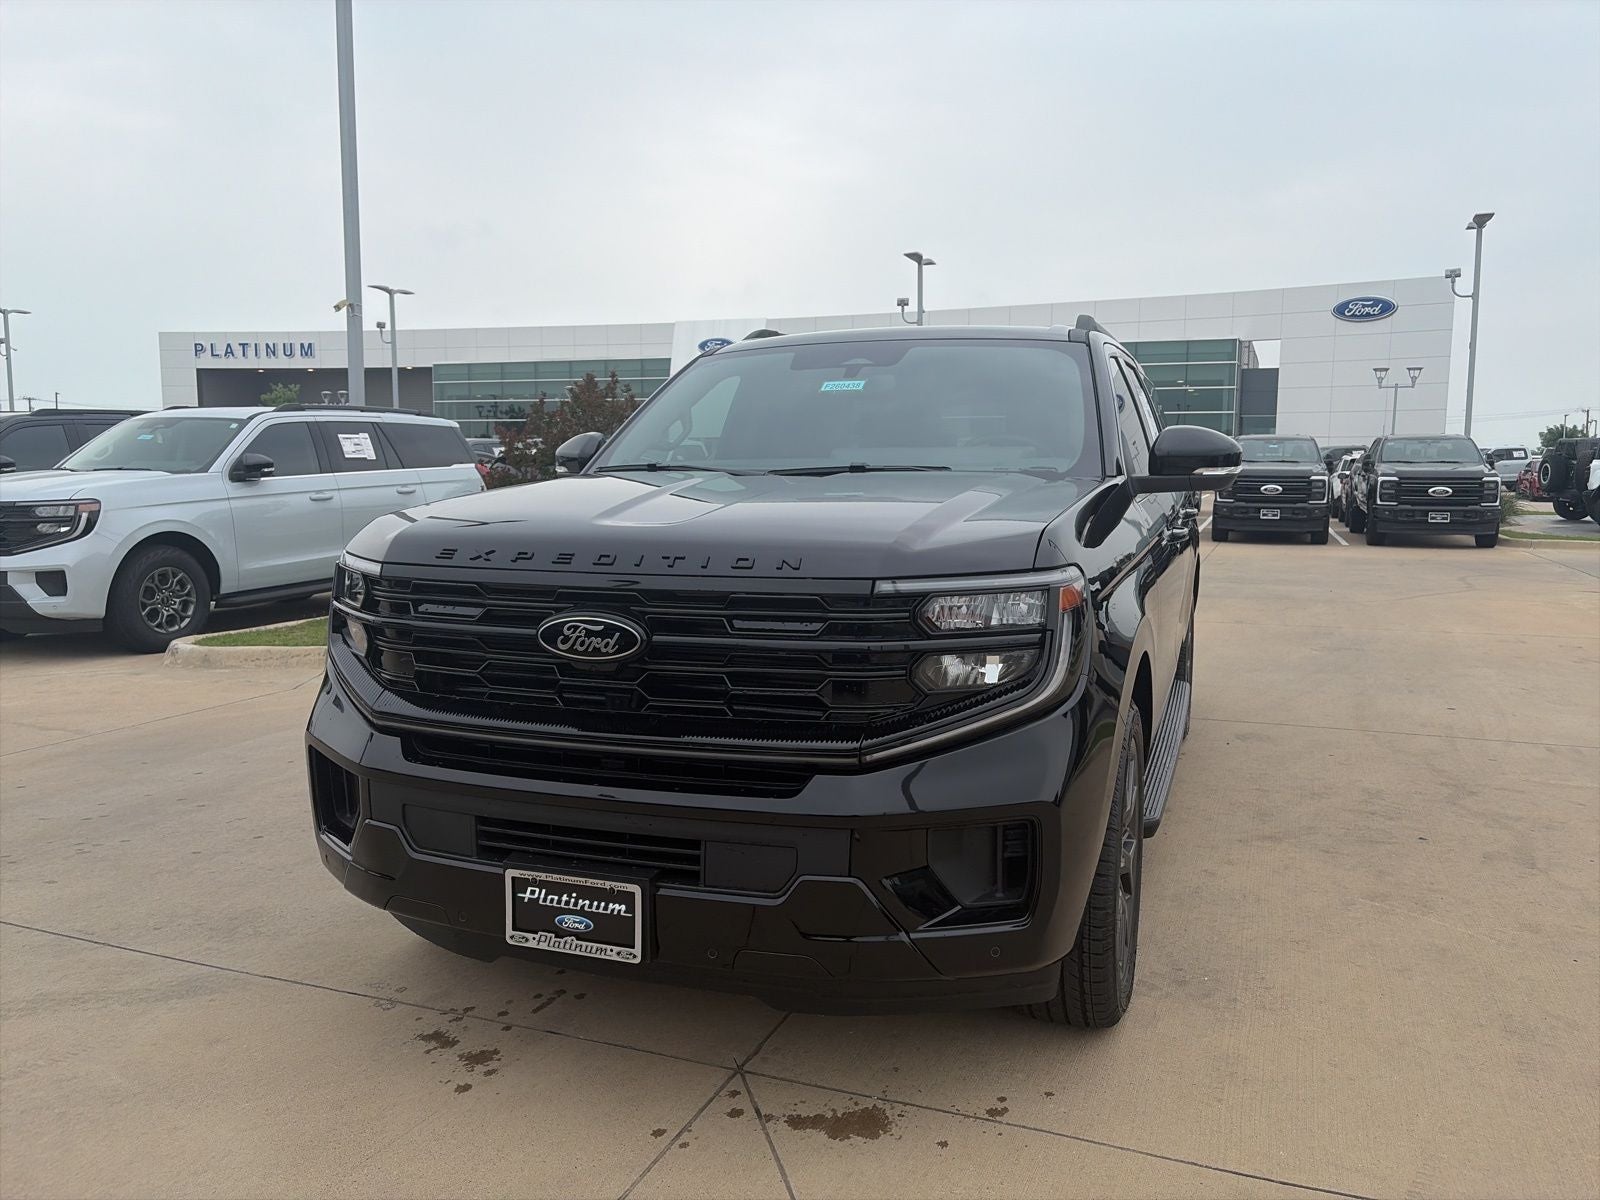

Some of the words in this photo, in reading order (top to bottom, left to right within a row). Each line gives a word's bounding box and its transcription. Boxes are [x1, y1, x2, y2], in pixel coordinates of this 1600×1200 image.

[1344, 300, 1383, 316] Ford
[193, 342, 315, 359] PLATINUM
[434, 547, 803, 571] EXPEDITION
[557, 621, 620, 654] Ford
[518, 871, 629, 890] www.PlatinumFord.com
[517, 886, 633, 917] Platinum
[561, 916, 586, 930] Ford
[536, 933, 614, 957] Platinum
